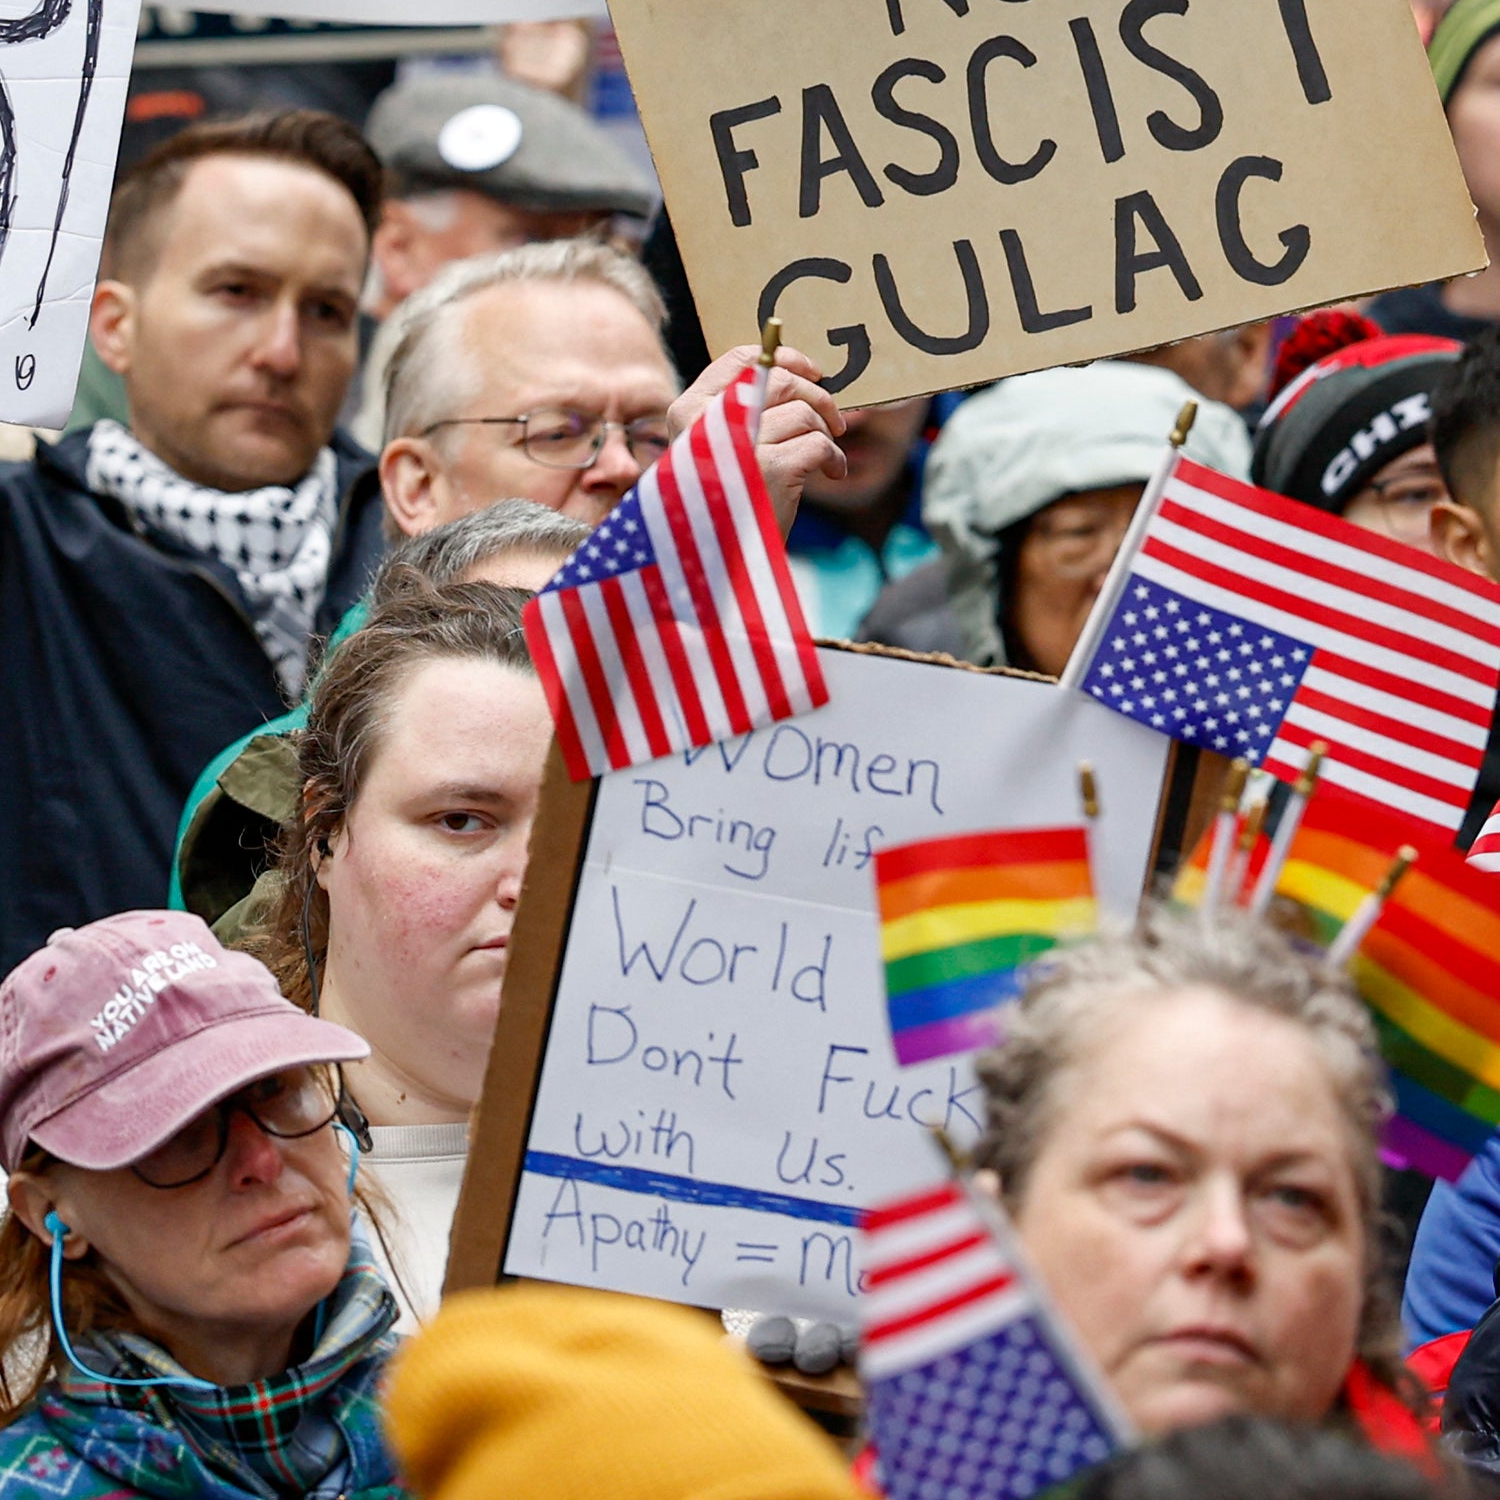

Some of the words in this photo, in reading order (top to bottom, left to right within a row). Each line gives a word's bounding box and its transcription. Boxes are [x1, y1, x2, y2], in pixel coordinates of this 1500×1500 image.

[757, 154, 1311, 395] GULAG
[631, 776, 777, 881] Bring
[89, 983, 135, 1030] YOU
[131, 950, 175, 988] ARE
[93, 970, 170, 1053] NATIVE
[164, 952, 218, 981] LAND
[610, 886, 832, 1014] World
[585, 1002, 744, 1102] Don't
[817, 1043, 986, 1133] Fuck
[573, 1110, 695, 1174] with
[541, 1175, 706, 1287] Apathy
